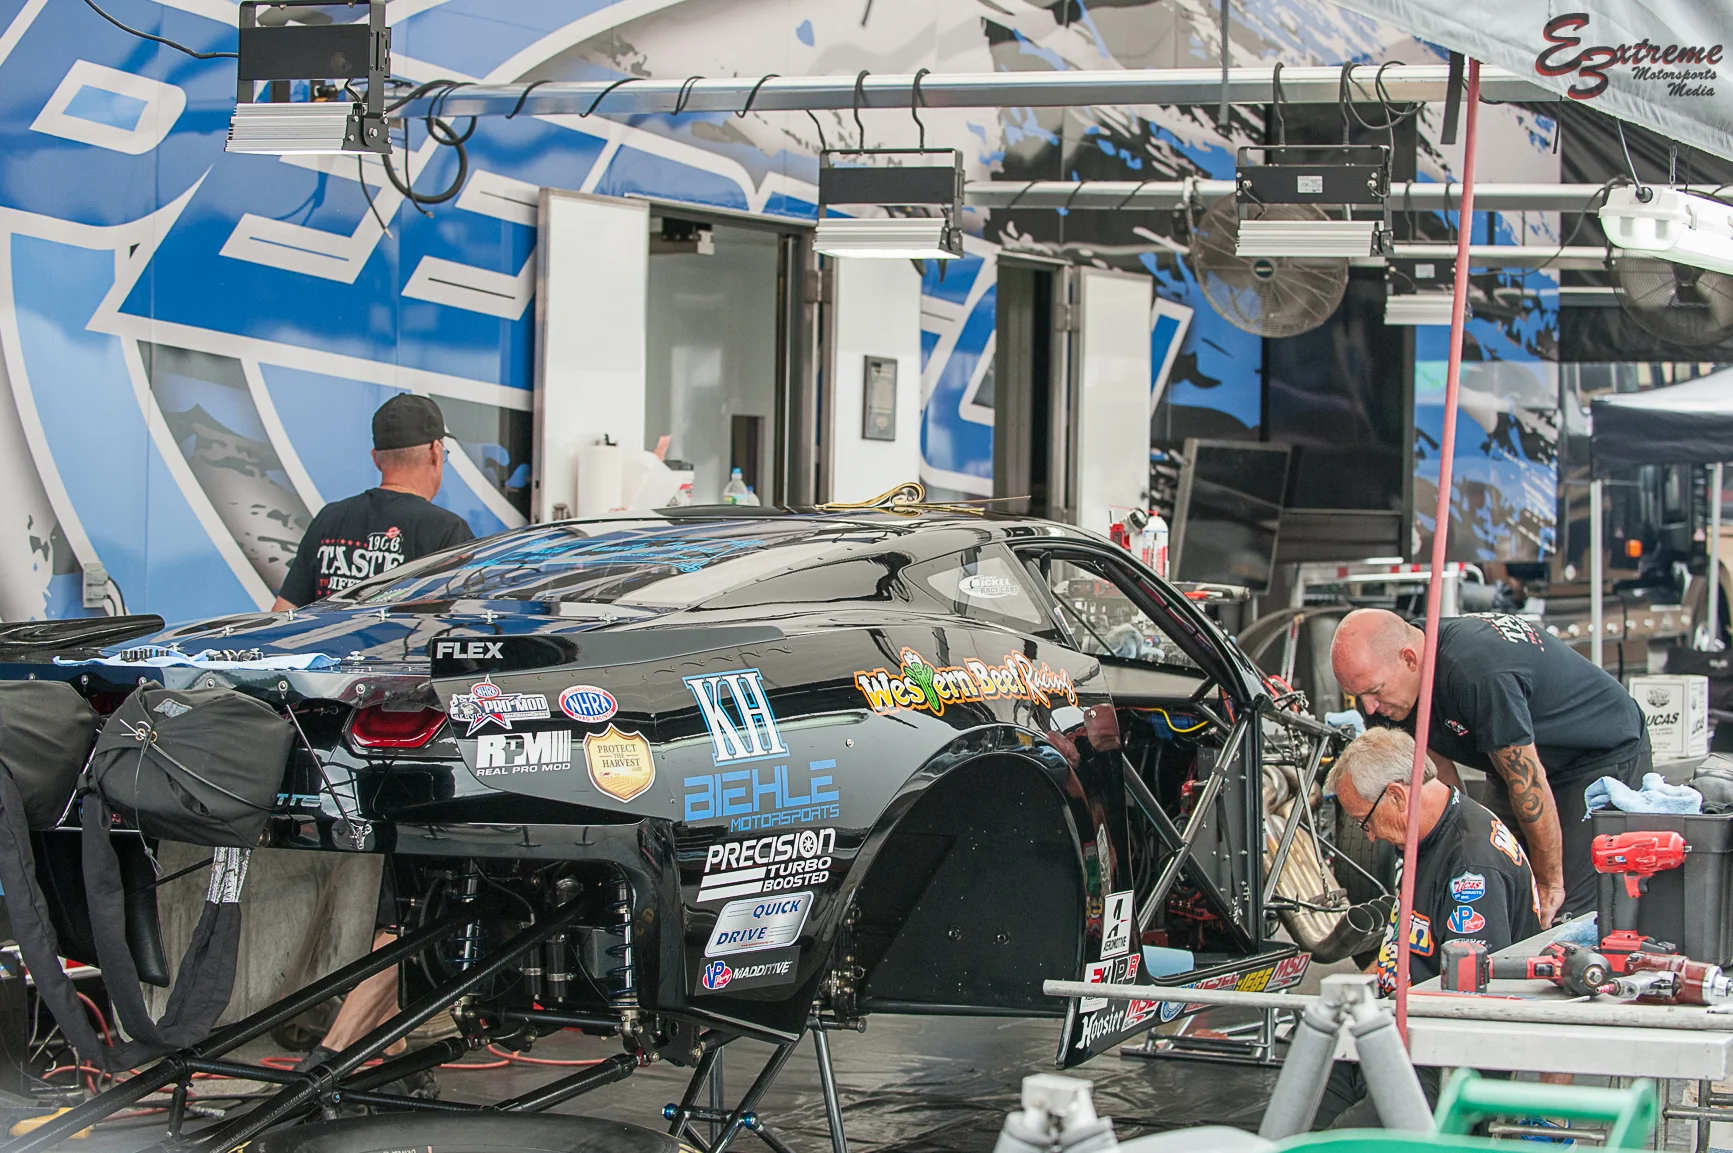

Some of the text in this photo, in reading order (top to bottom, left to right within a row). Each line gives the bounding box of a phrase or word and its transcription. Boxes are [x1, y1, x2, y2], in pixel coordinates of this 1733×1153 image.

[317, 545, 405, 578] TASTE
[972, 578, 1012, 588] BICKEL
[436, 642, 504, 659] FLEX
[966, 657, 1028, 698] Beef
[1011, 653, 1077, 704] Racing
[475, 685, 498, 697] NHRA
[483, 697, 547, 713] PRO MOD
[568, 692, 611, 716] NHRA
[683, 669, 789, 765] KH
[1646, 712, 1680, 727] UCAS
[597, 744, 637, 753] PROTECT
[476, 762, 571, 777] REAL PRO MOD
[602, 758, 641, 768] HARVEST
[683, 758, 840, 822] BIEHLE
[730, 803, 840, 833] MOTORSPORTS
[704, 827, 836, 873] PRECISION
[766, 856, 832, 878] TURBO
[762, 870, 830, 892] BOOSTED
[752, 899, 802, 919] QUICK
[1450, 905, 1474, 933] VP
[716, 926, 768, 946] DRIVE
[706, 961, 725, 989] VP
[1271, 953, 1310, 981] MSD
[1240, 967, 1274, 992] JEGS
[1075, 1004, 1125, 1050] Hoosier
